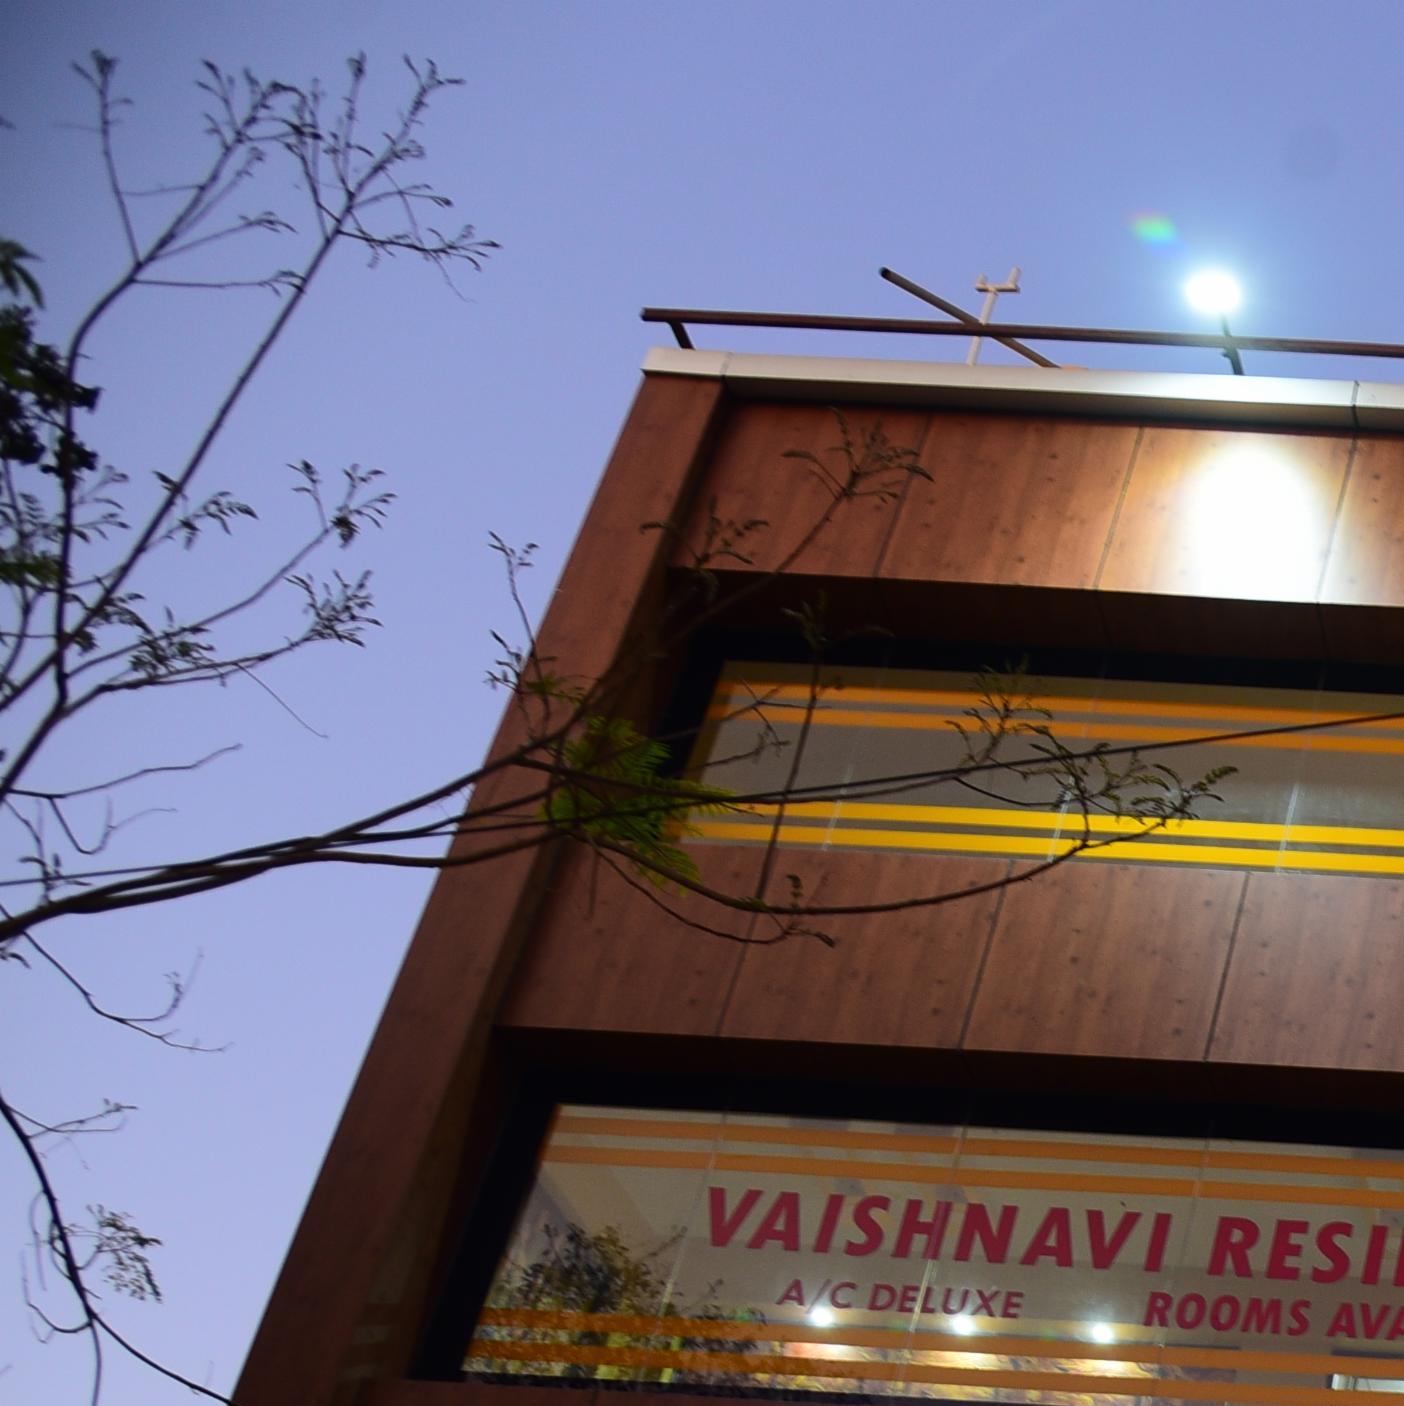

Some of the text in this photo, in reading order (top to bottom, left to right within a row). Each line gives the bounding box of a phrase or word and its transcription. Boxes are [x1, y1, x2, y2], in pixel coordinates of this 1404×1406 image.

[707, 1186, 1172, 1274] VAISHNAVI
[775, 1279, 858, 1310] A/C
[867, 1283, 1025, 1319] DELUXE
[1144, 1290, 1311, 1336] ROOMS
